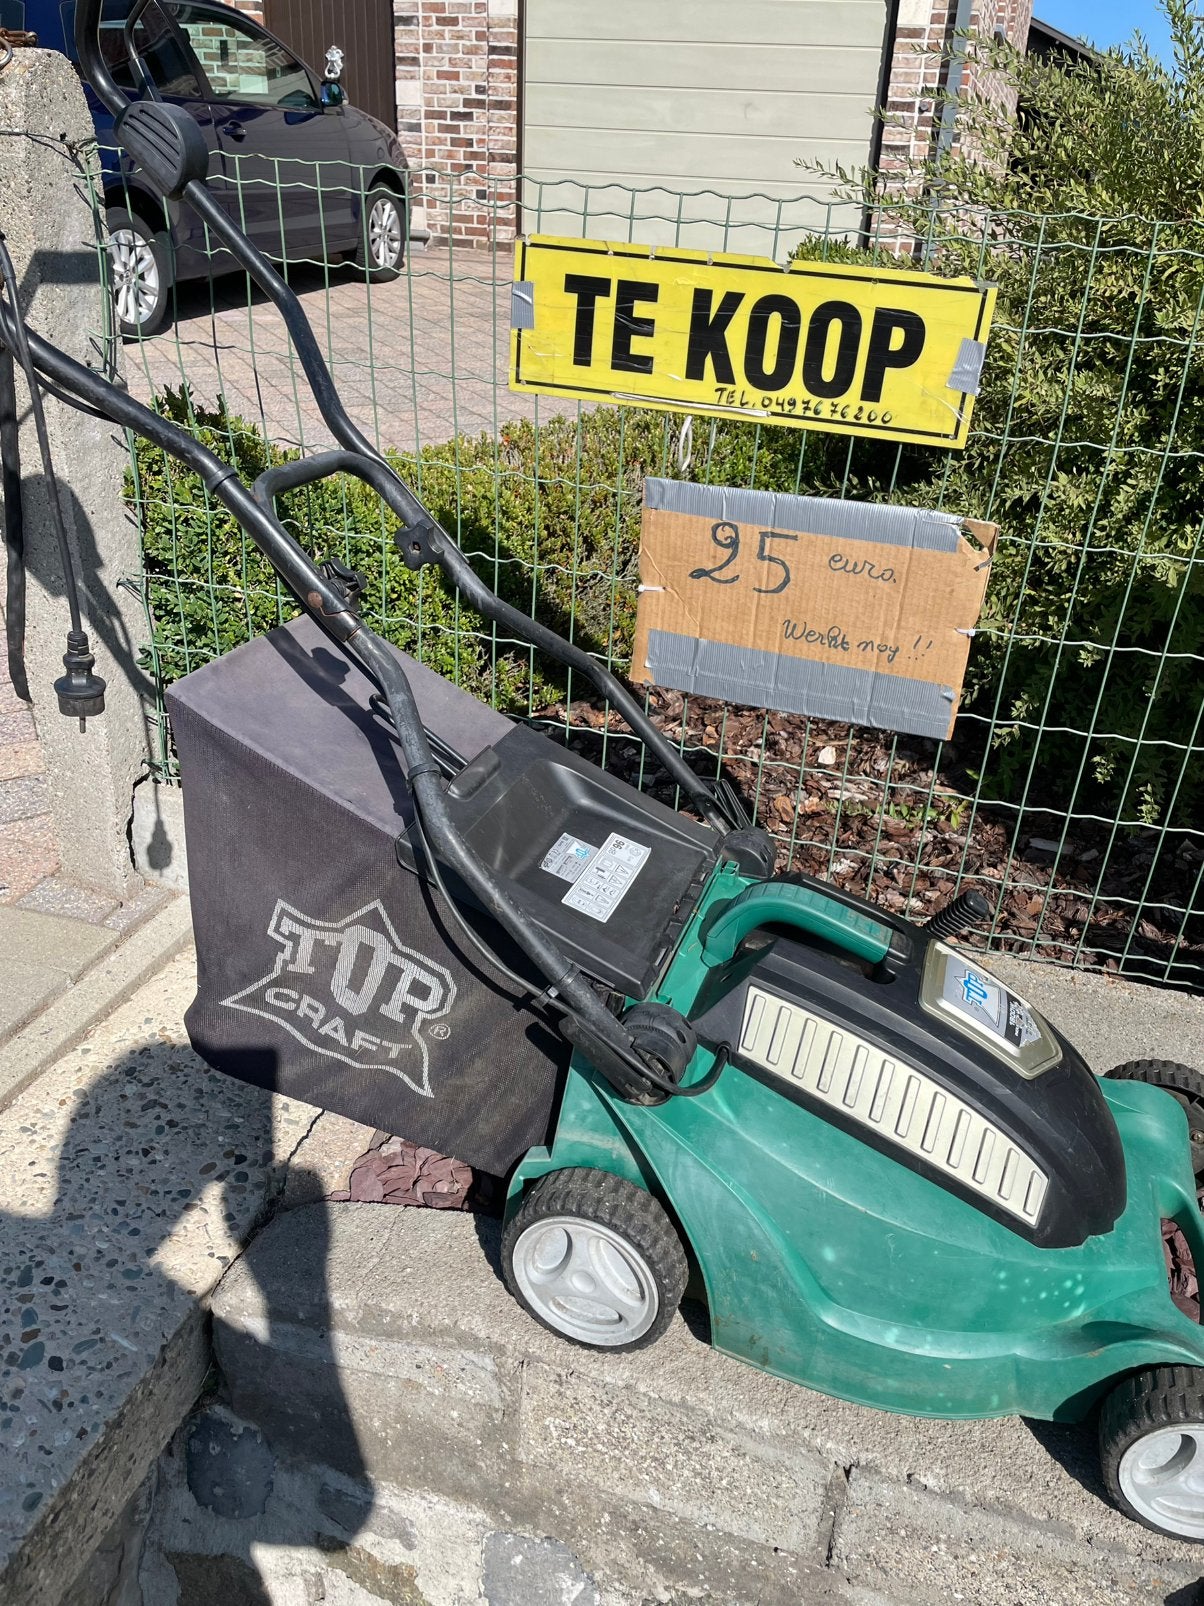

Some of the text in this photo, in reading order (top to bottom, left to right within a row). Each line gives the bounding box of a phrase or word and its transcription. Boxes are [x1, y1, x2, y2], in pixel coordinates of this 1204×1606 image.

[564, 273, 926, 402] TE KOOP
[688, 521, 799, 594] 25
[279, 916, 444, 1023] TOP
[963, 972, 988, 1006] TOP
[265, 987, 413, 1059] CRAFT
